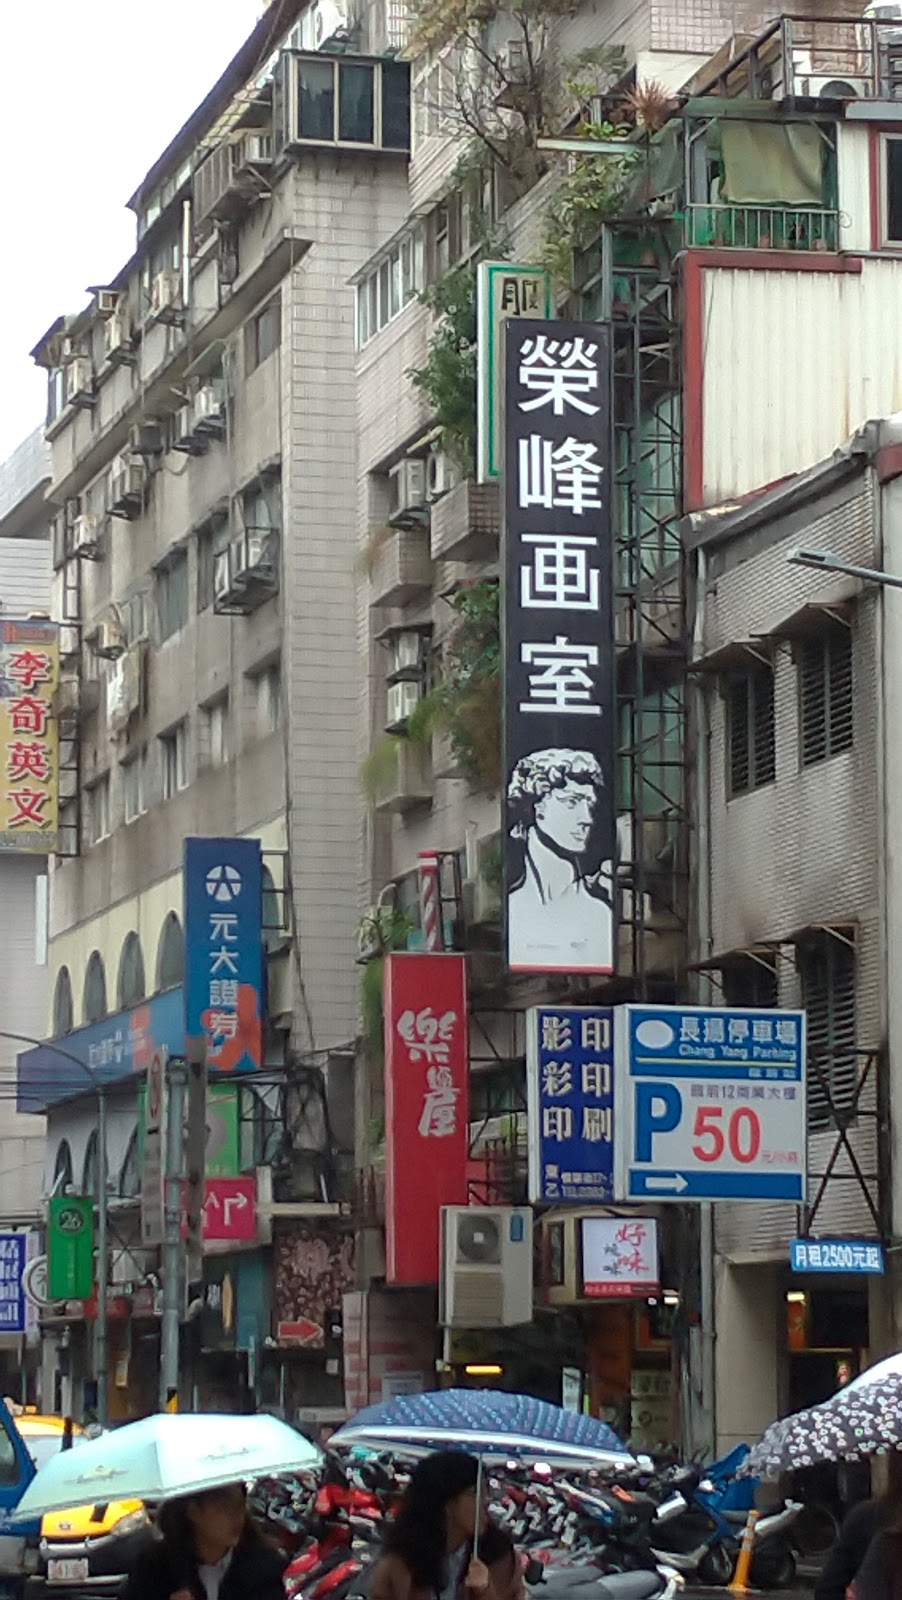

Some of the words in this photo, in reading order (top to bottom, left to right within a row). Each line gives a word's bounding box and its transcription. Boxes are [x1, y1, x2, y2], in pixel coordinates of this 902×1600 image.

[518, 335, 604, 714] 榮峰画室
[8, 650, 48, 826] 李奇英文
[208, 913, 240, 1039] 元大證券
[541, 1015, 611, 1052] 影印
[678, 1044, 716, 1059] Chang
[720, 1046, 748, 1061] Yang
[752, 1046, 797, 1062] Parking
[542, 1106, 612, 1143] 印刷
[634, 1081, 683, 1163] P
[692, 1105, 761, 1164] 50
[795, 1244, 880, 1269] 月租2500元起
